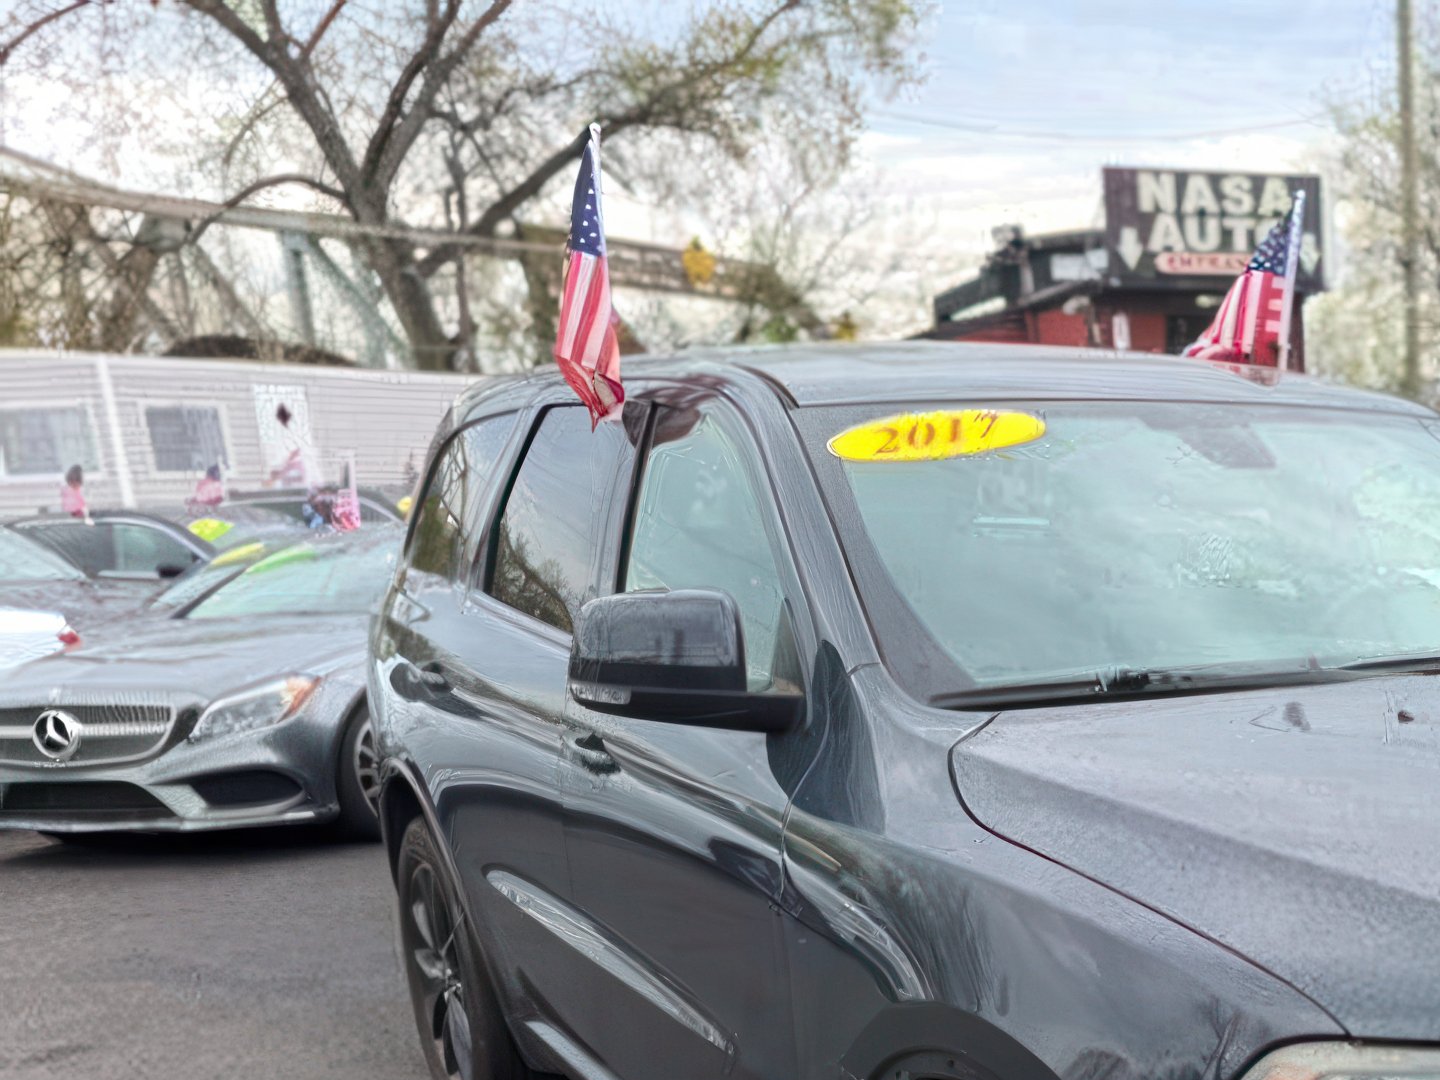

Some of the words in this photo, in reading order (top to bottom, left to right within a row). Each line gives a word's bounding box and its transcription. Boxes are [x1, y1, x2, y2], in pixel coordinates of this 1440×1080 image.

[1137, 172, 1292, 216] NASA
[1148, 213, 1281, 253] AUT
[874, 411, 999, 454] 2017
